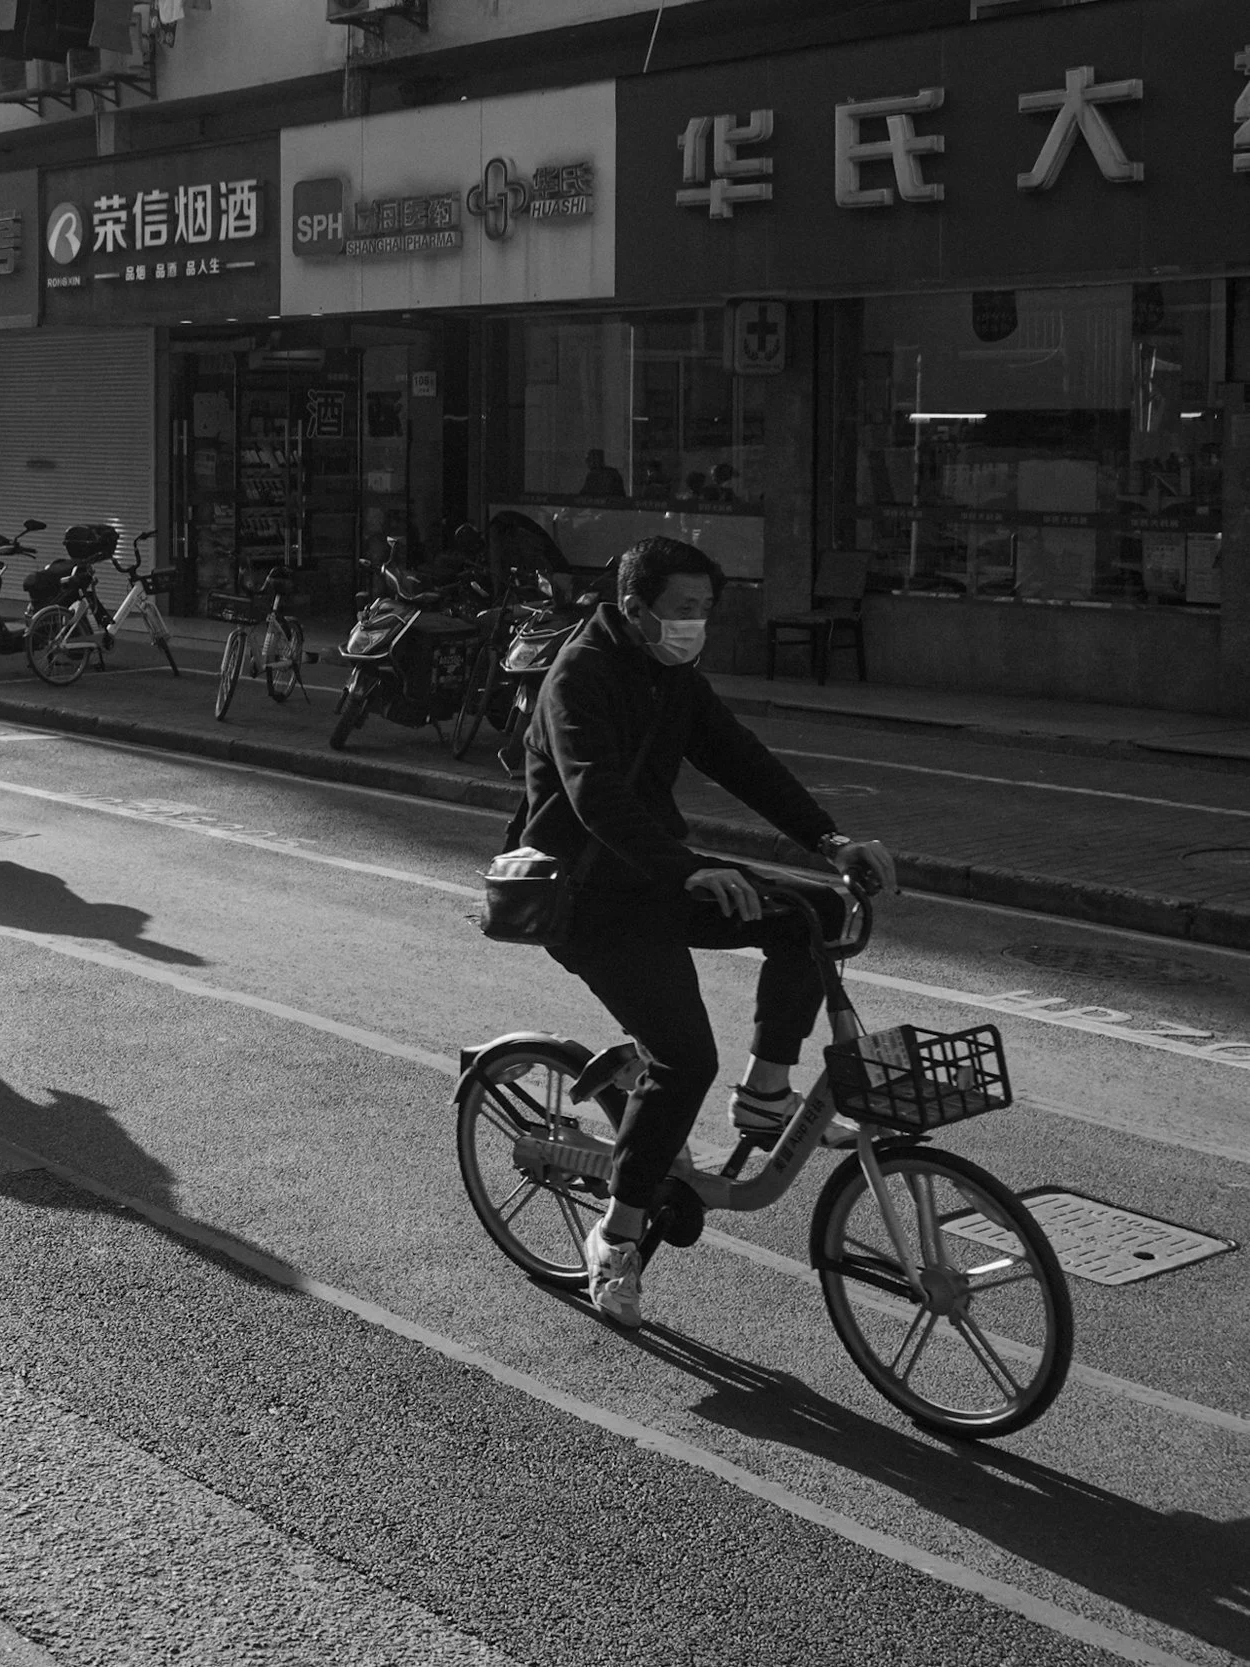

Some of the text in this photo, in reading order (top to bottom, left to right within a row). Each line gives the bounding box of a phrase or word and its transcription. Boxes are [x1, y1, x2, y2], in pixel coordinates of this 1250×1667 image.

[675, 43, 1250, 221] 华氏大
[532, 161, 592, 198] 华氏
[92, 178, 258, 253] 荣信烟酒
[531, 196, 587, 219] HUASHI
[296, 211, 343, 243] SPH
[345, 231, 456, 256] SHANGHAI PHARMA
[46, 275, 81, 289] RONGXIN
[125, 257, 221, 281] 品烟 品酒 品人生
[306, 389, 346, 439] 酒
